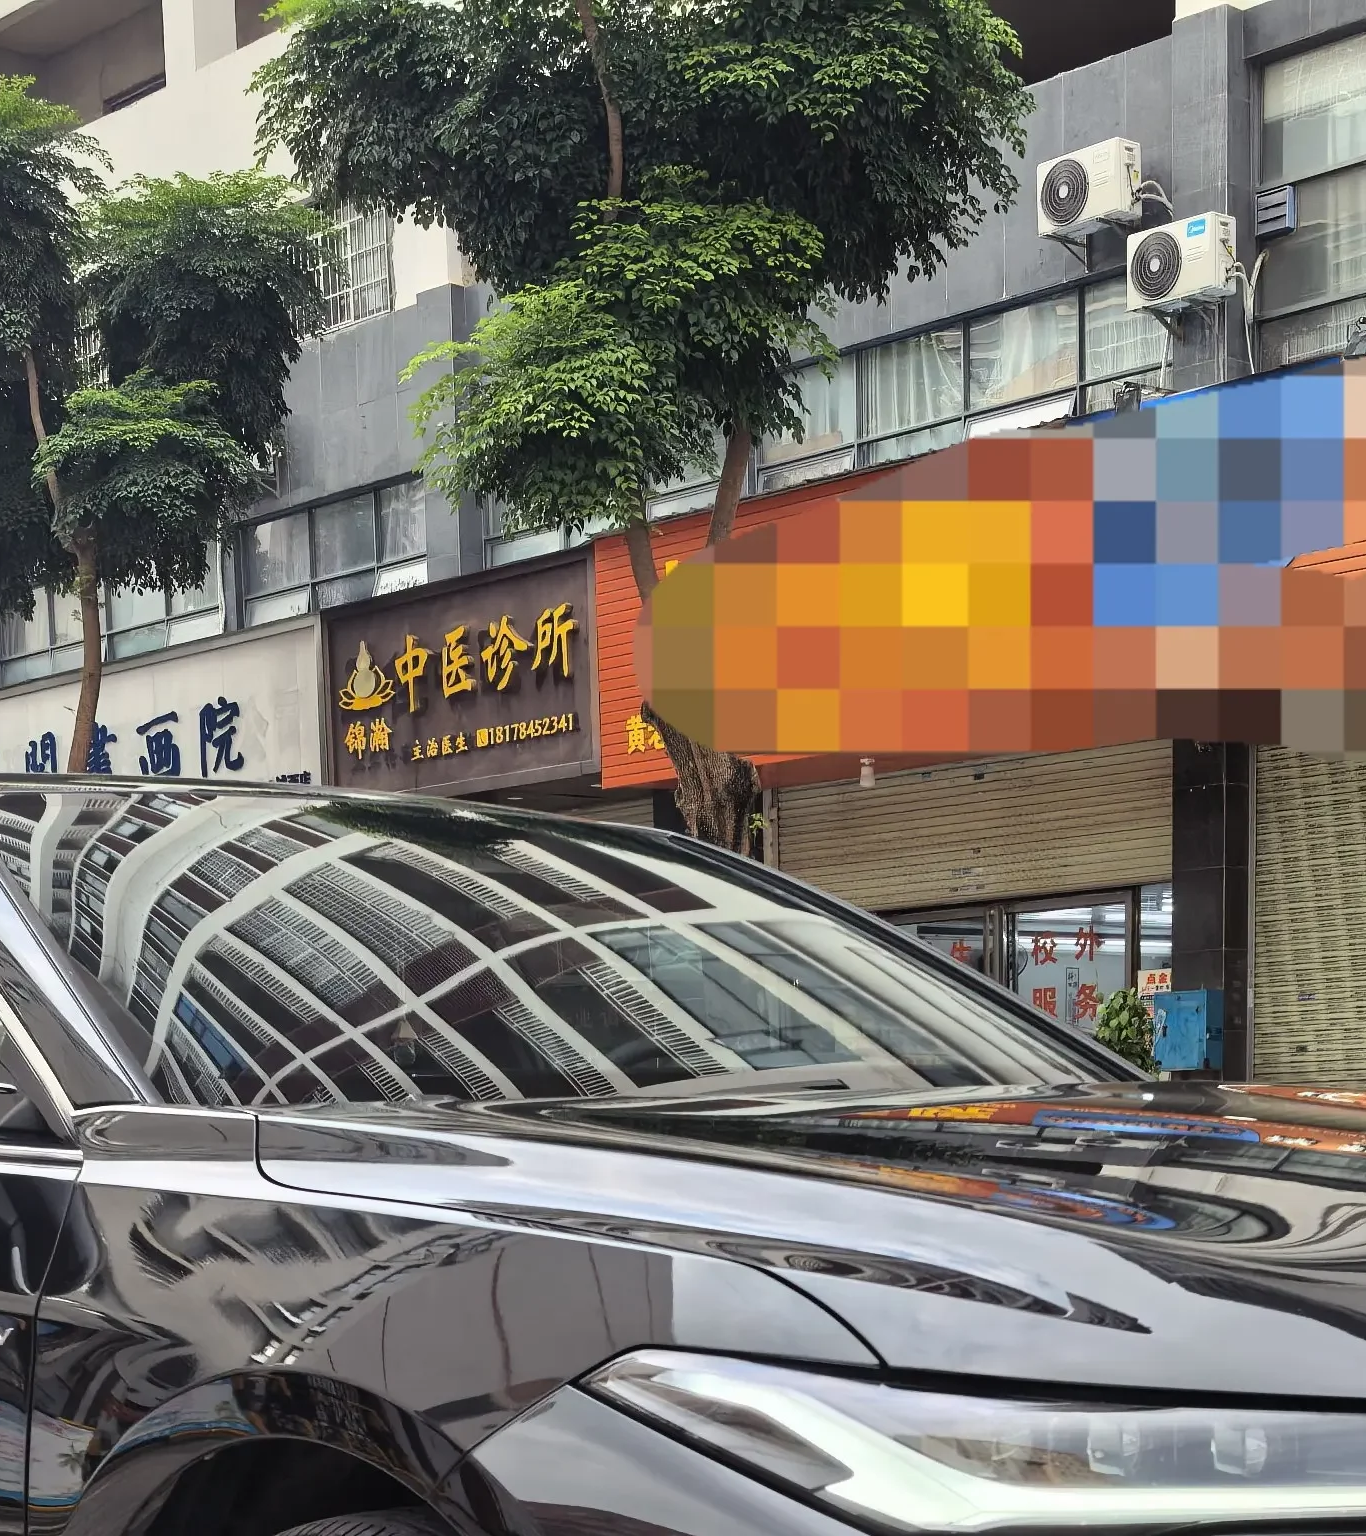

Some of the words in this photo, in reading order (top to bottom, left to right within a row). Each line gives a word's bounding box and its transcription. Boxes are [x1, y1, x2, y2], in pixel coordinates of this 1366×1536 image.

[394, 602, 579, 713] 中医诊所
[343, 717, 393, 760] 锦瀚
[410, 731, 469, 762] 主治医生
[487, 713, 575, 747] 18178452341
